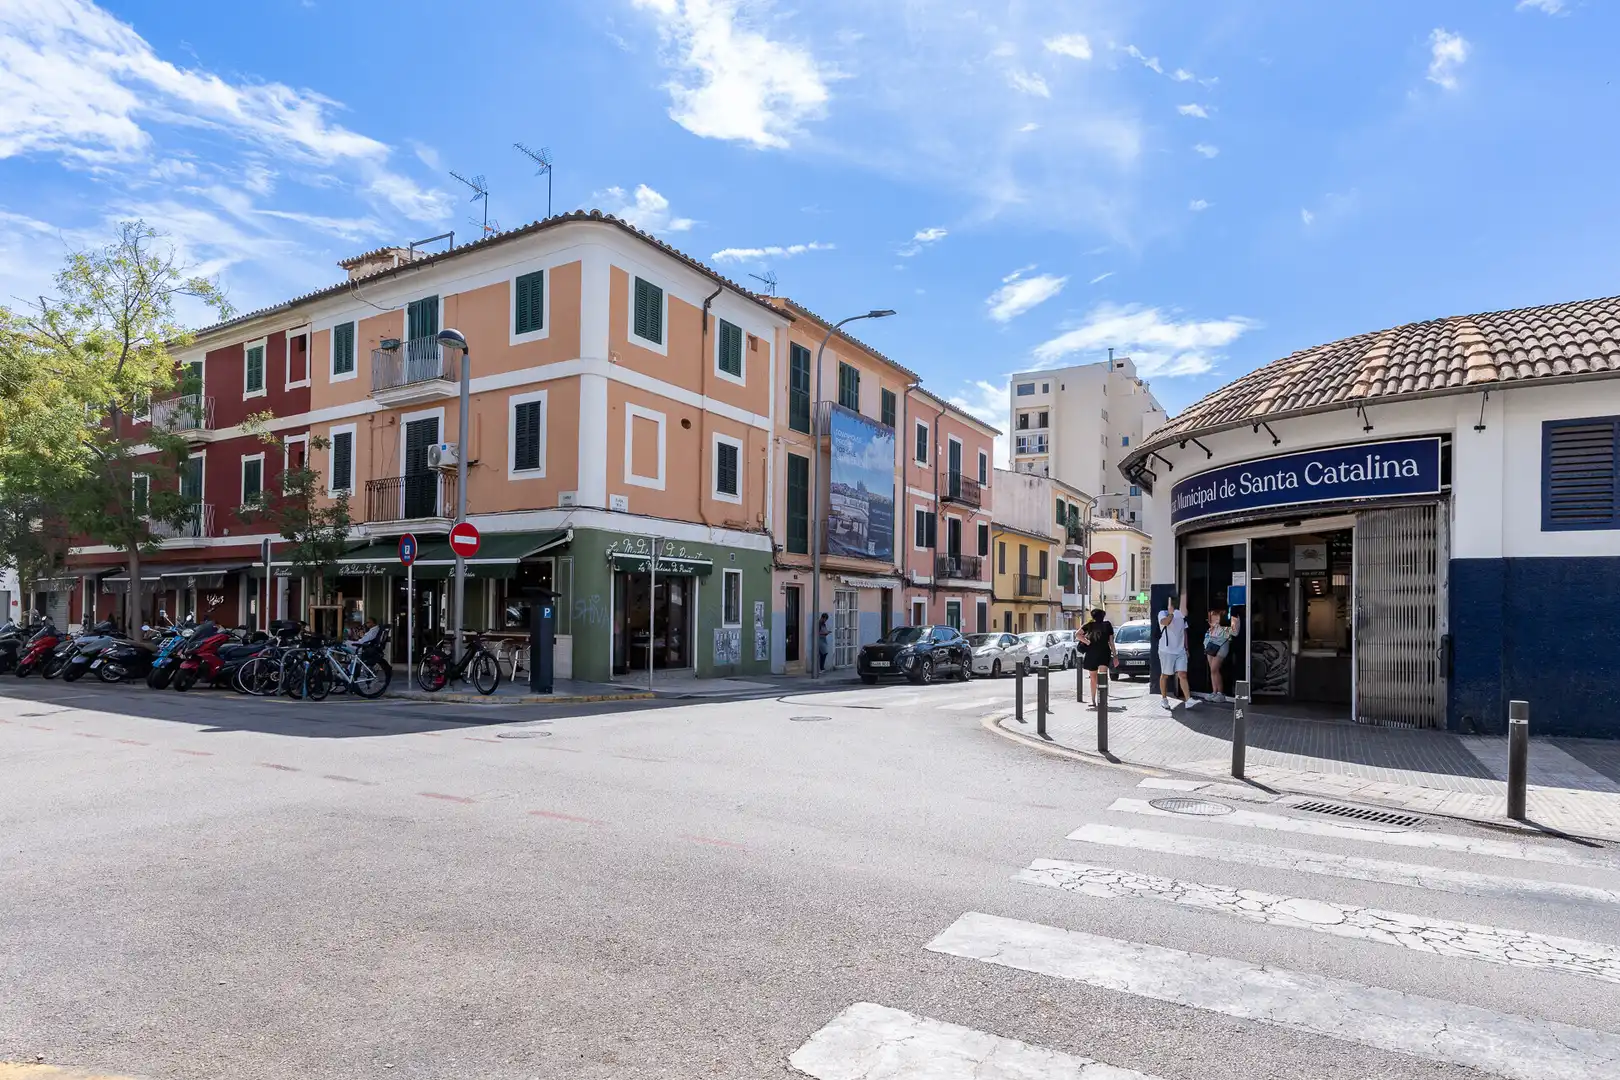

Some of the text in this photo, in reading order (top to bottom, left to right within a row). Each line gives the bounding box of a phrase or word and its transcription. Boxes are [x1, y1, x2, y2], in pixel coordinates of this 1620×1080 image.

[1177, 481, 1218, 509] Municipal
[1220, 477, 1236, 499] de
[1239, 471, 1299, 496] Santa
[1304, 454, 1421, 487] Catalina
